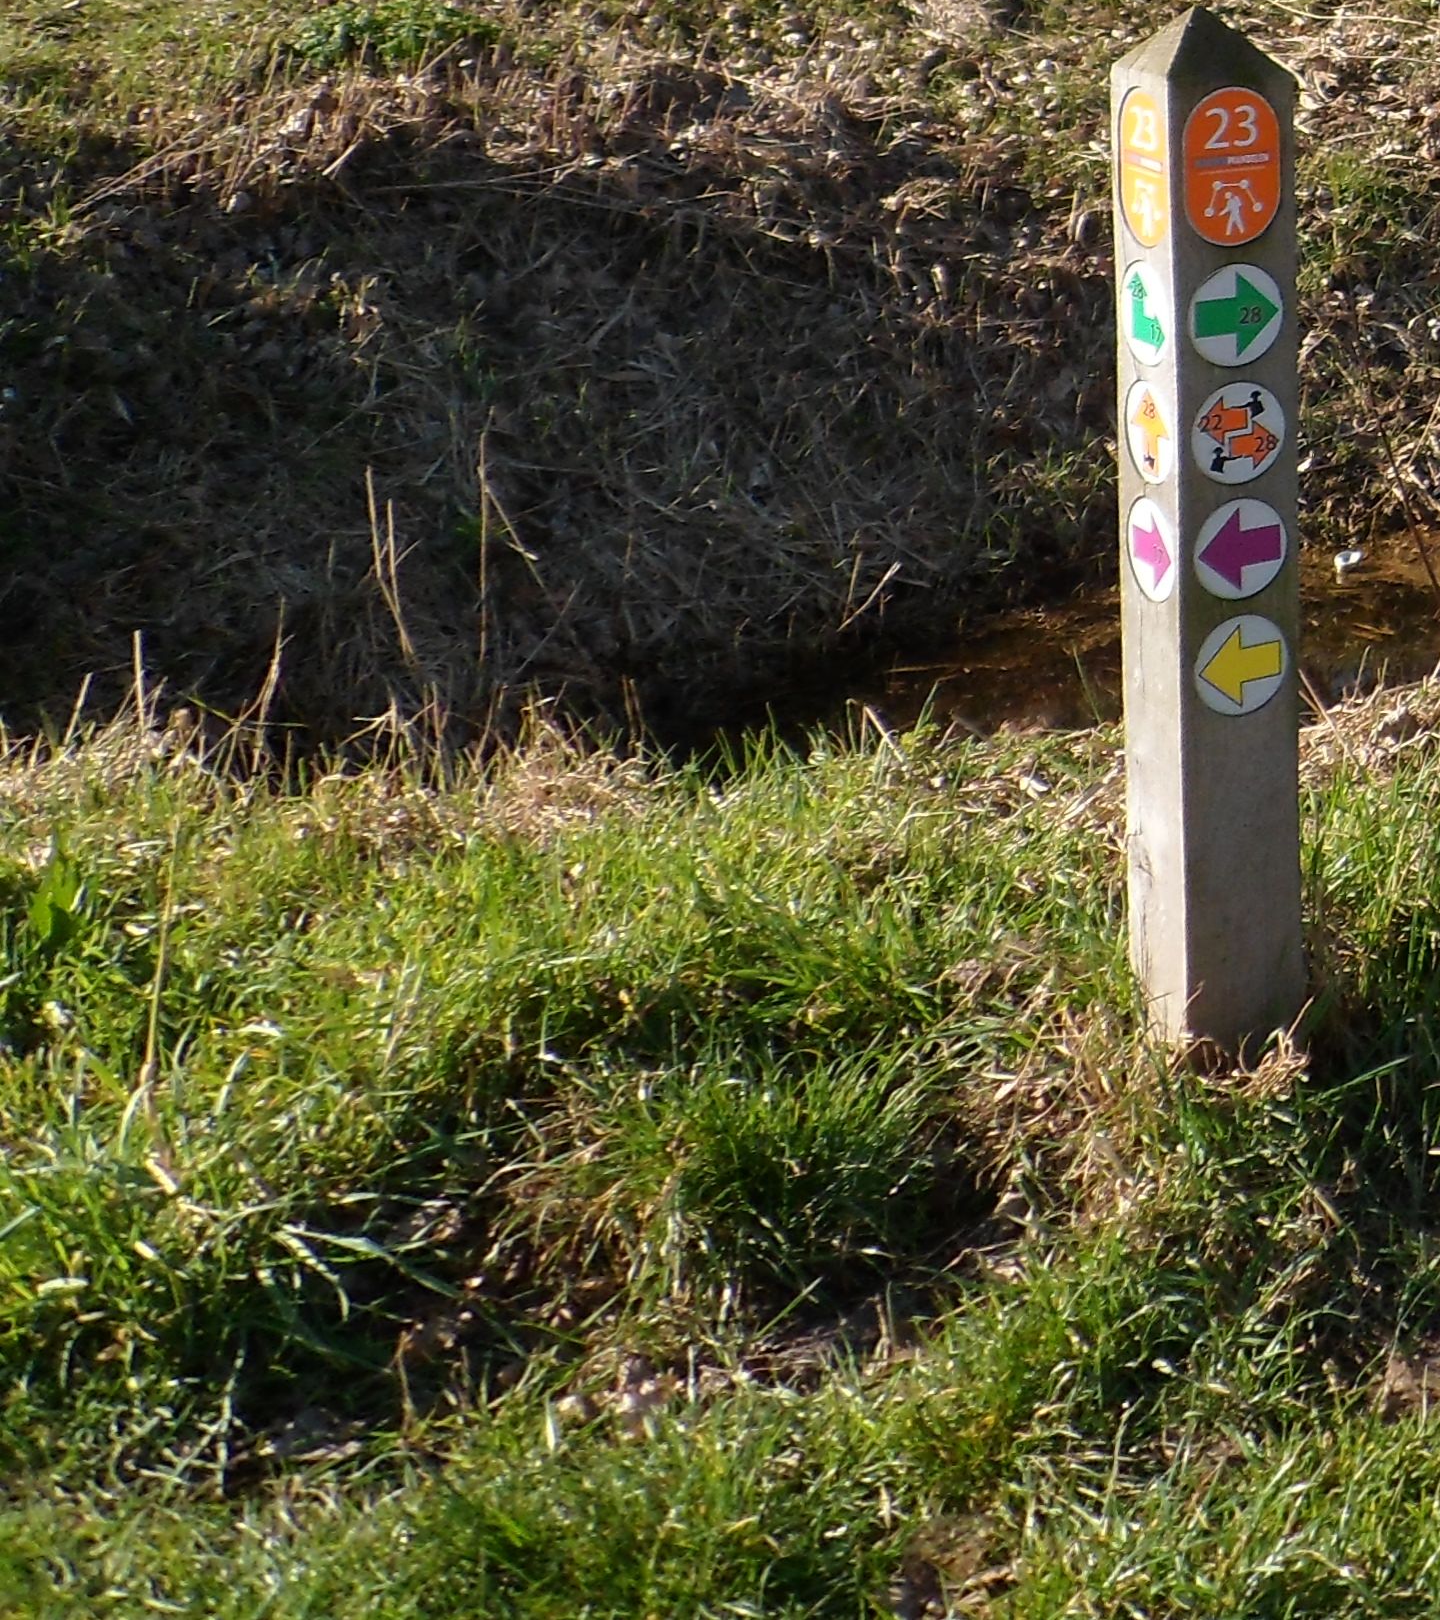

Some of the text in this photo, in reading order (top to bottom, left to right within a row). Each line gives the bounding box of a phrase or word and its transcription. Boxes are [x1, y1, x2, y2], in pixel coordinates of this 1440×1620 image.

[1130, 106, 1159, 151] 23
[1204, 105, 1258, 150] 23
[1239, 306, 1262, 325] 28
[1199, 414, 1222, 433] 22
[1255, 434, 1278, 454] 28
